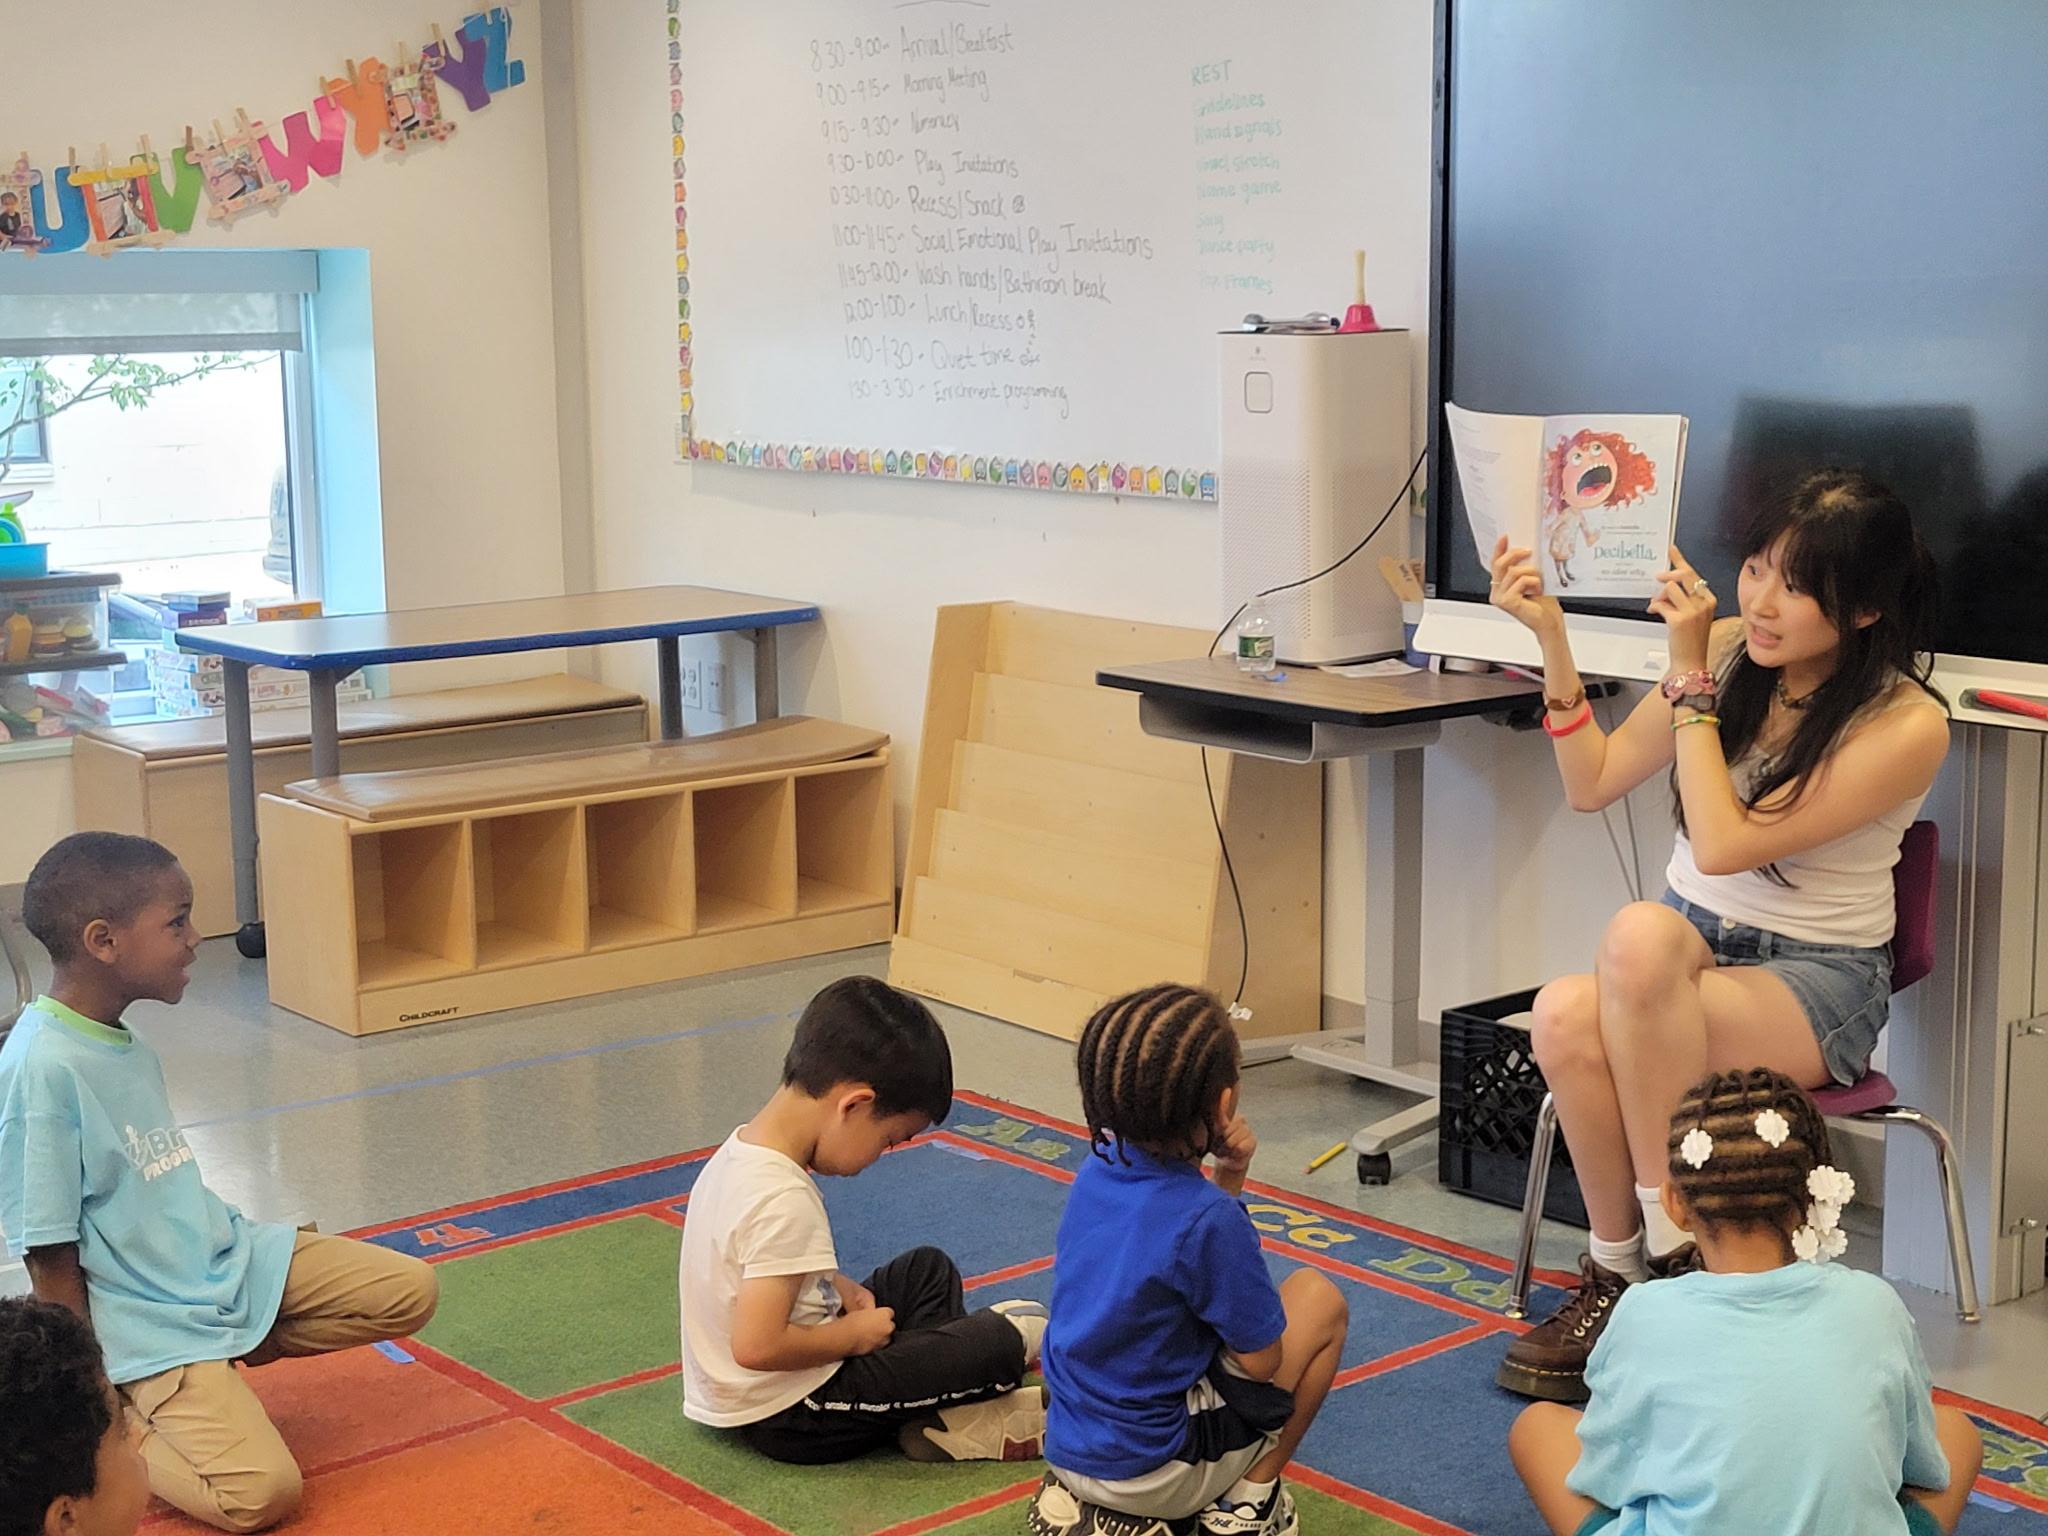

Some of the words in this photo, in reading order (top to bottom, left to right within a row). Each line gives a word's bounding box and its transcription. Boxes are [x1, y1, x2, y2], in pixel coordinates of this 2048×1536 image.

[1191, 58, 1233, 87] REST
[914, 148, 946, 186] Play
[910, 223, 955, 254] Social
[956, 225, 1024, 254] Emotional
[1027, 225, 1060, 275] Play
